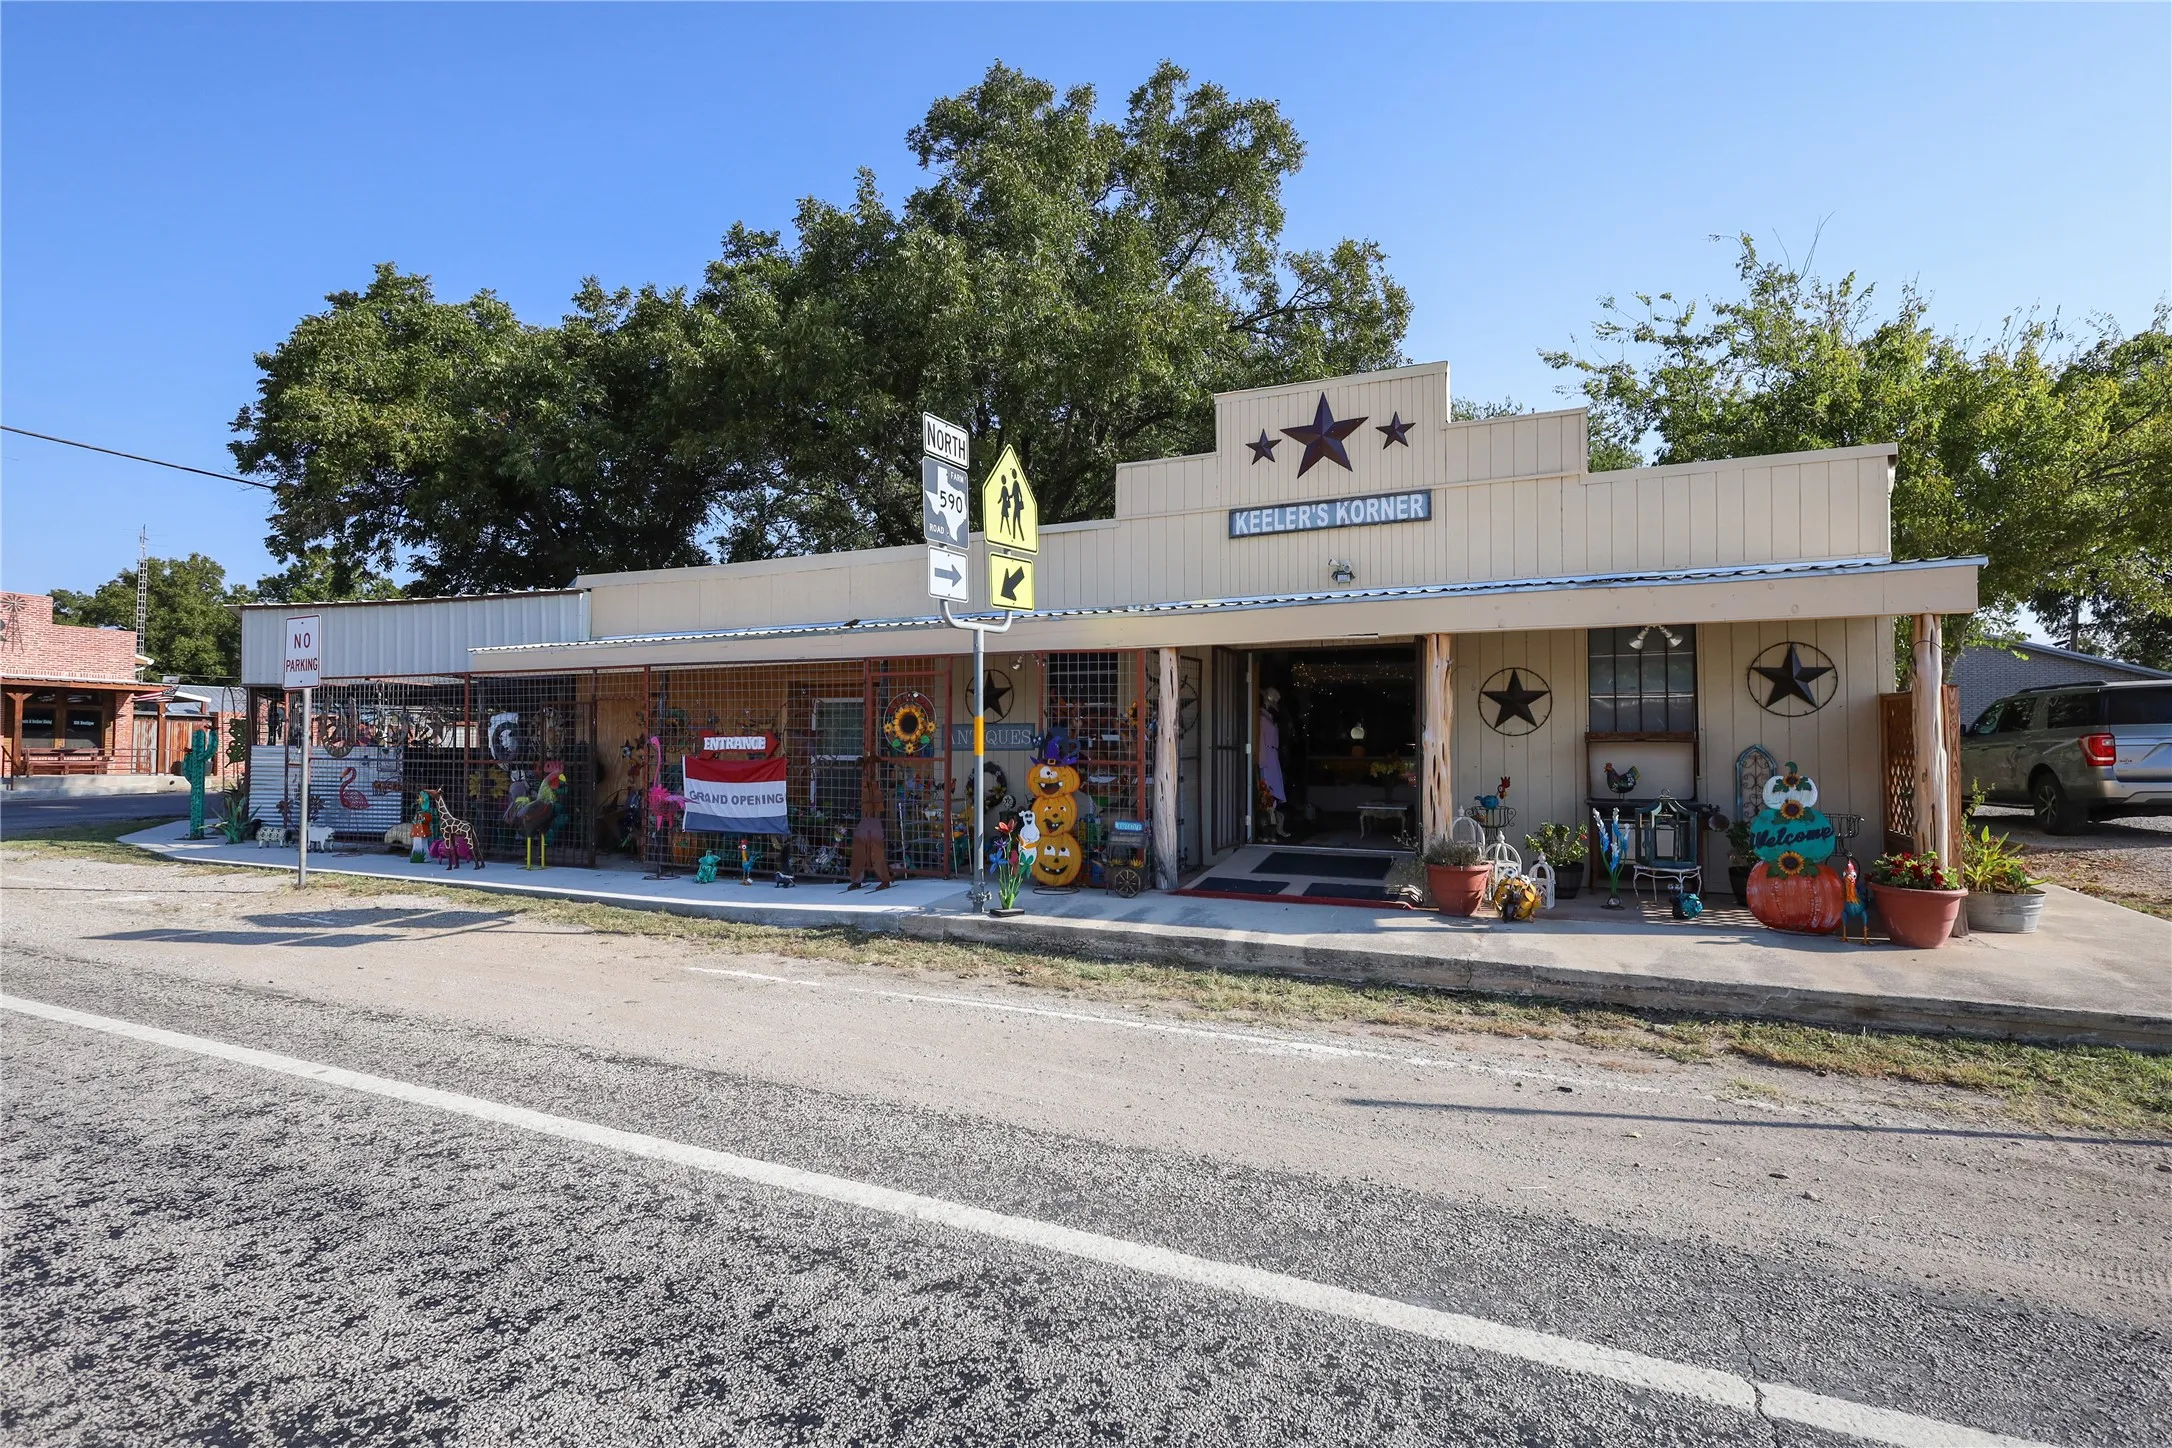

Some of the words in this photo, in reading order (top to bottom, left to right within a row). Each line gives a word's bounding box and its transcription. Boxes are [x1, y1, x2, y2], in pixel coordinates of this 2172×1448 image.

[927, 421, 966, 460] NORTH
[950, 471, 964, 484] FARM
[940, 490, 963, 514] 590
[1235, 503, 1329, 535] KEELER'S
[1336, 493, 1425, 525] KORNER
[929, 523, 945, 535] ROAD
[294, 632, 311, 649] NO
[285, 657, 318, 673] PARKING
[703, 736, 767, 750] ENTRANCE
[947, 729, 1032, 745] NQUES
[689, 790, 729, 805] GRAND
[731, 793, 785, 806] OPENING
[1750, 826, 1834, 850] Welcome
